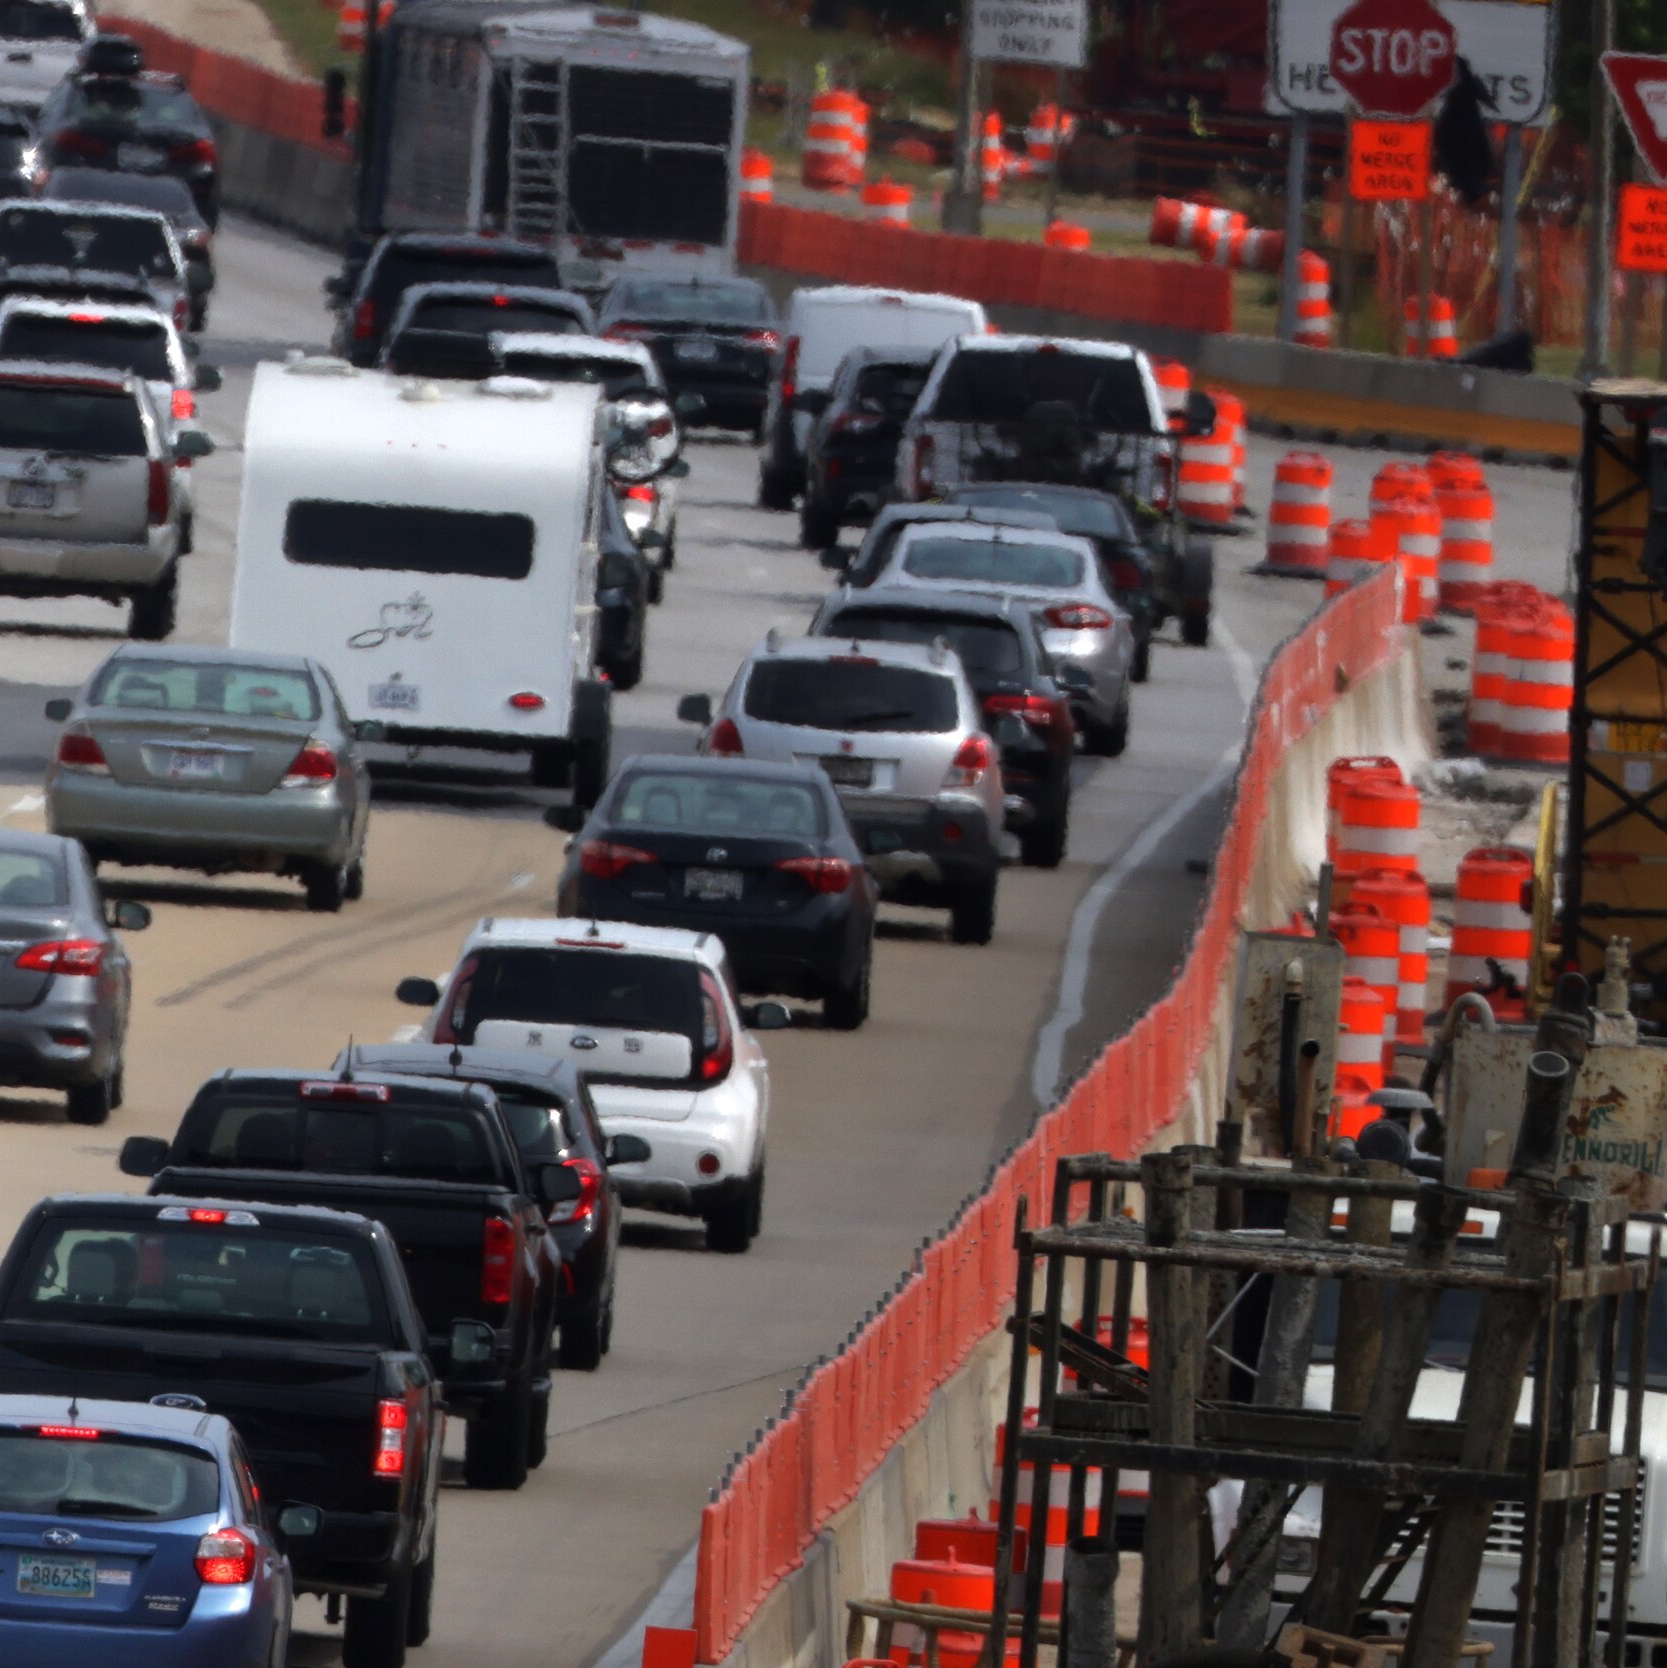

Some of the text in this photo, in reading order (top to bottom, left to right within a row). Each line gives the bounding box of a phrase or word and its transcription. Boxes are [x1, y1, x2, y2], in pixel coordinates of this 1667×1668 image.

[1336, 27, 1450, 77] STOP
[1378, 131, 1402, 148] NO
[1361, 152, 1416, 170] MERGE
[1364, 175, 1413, 191] AREA
